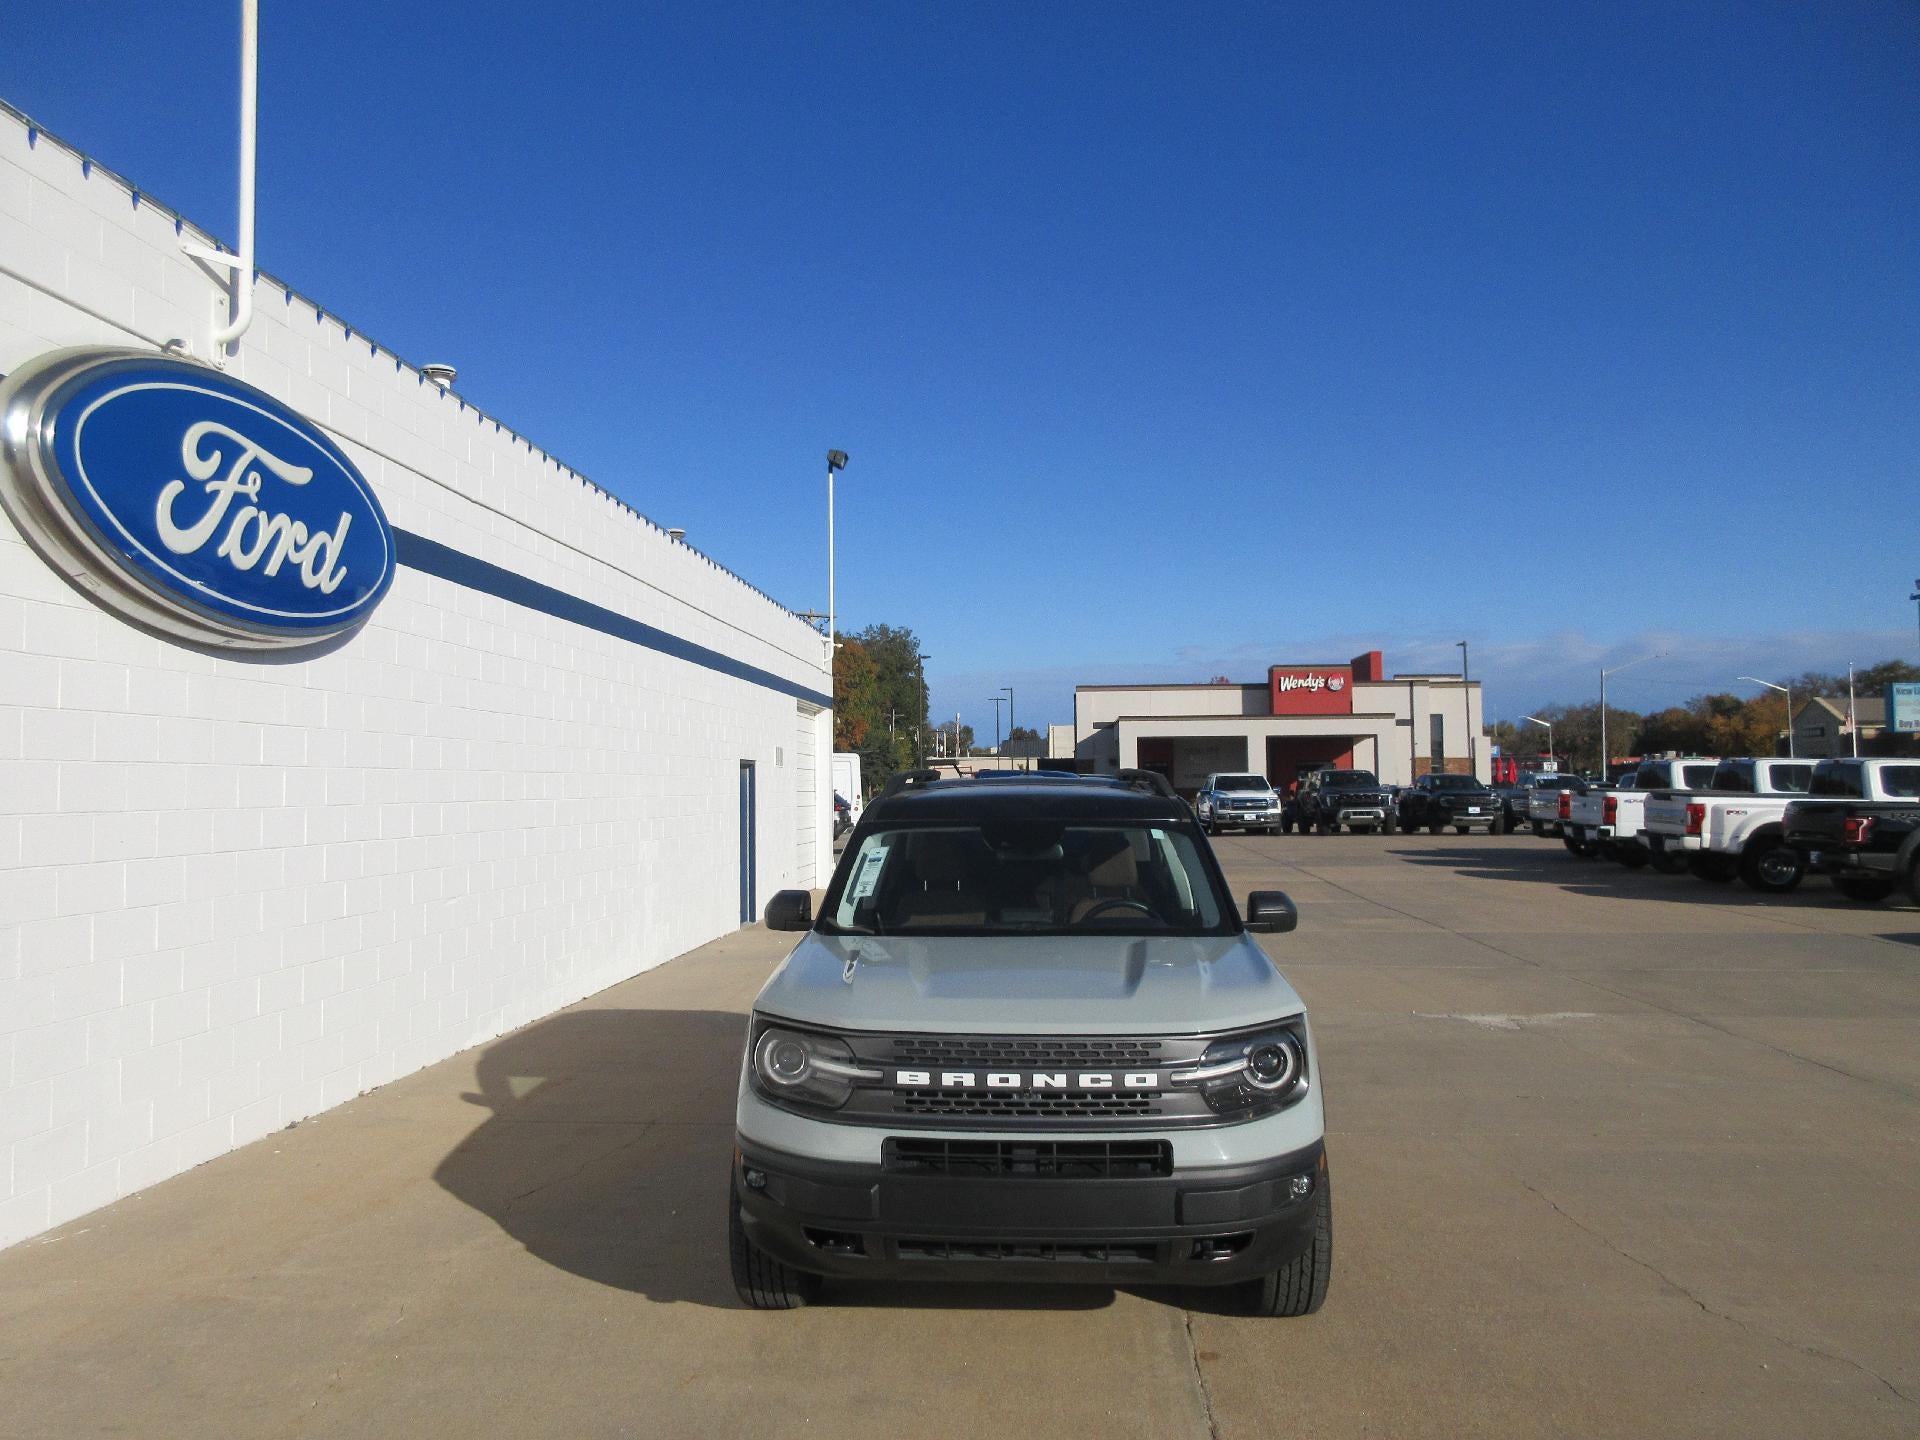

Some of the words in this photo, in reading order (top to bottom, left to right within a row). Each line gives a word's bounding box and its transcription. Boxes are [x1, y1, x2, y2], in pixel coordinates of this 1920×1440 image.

[156, 421, 353, 594] Ford
[1280, 672, 1325, 692] Wendy's
[896, 1070, 1158, 1088] BRONCO
